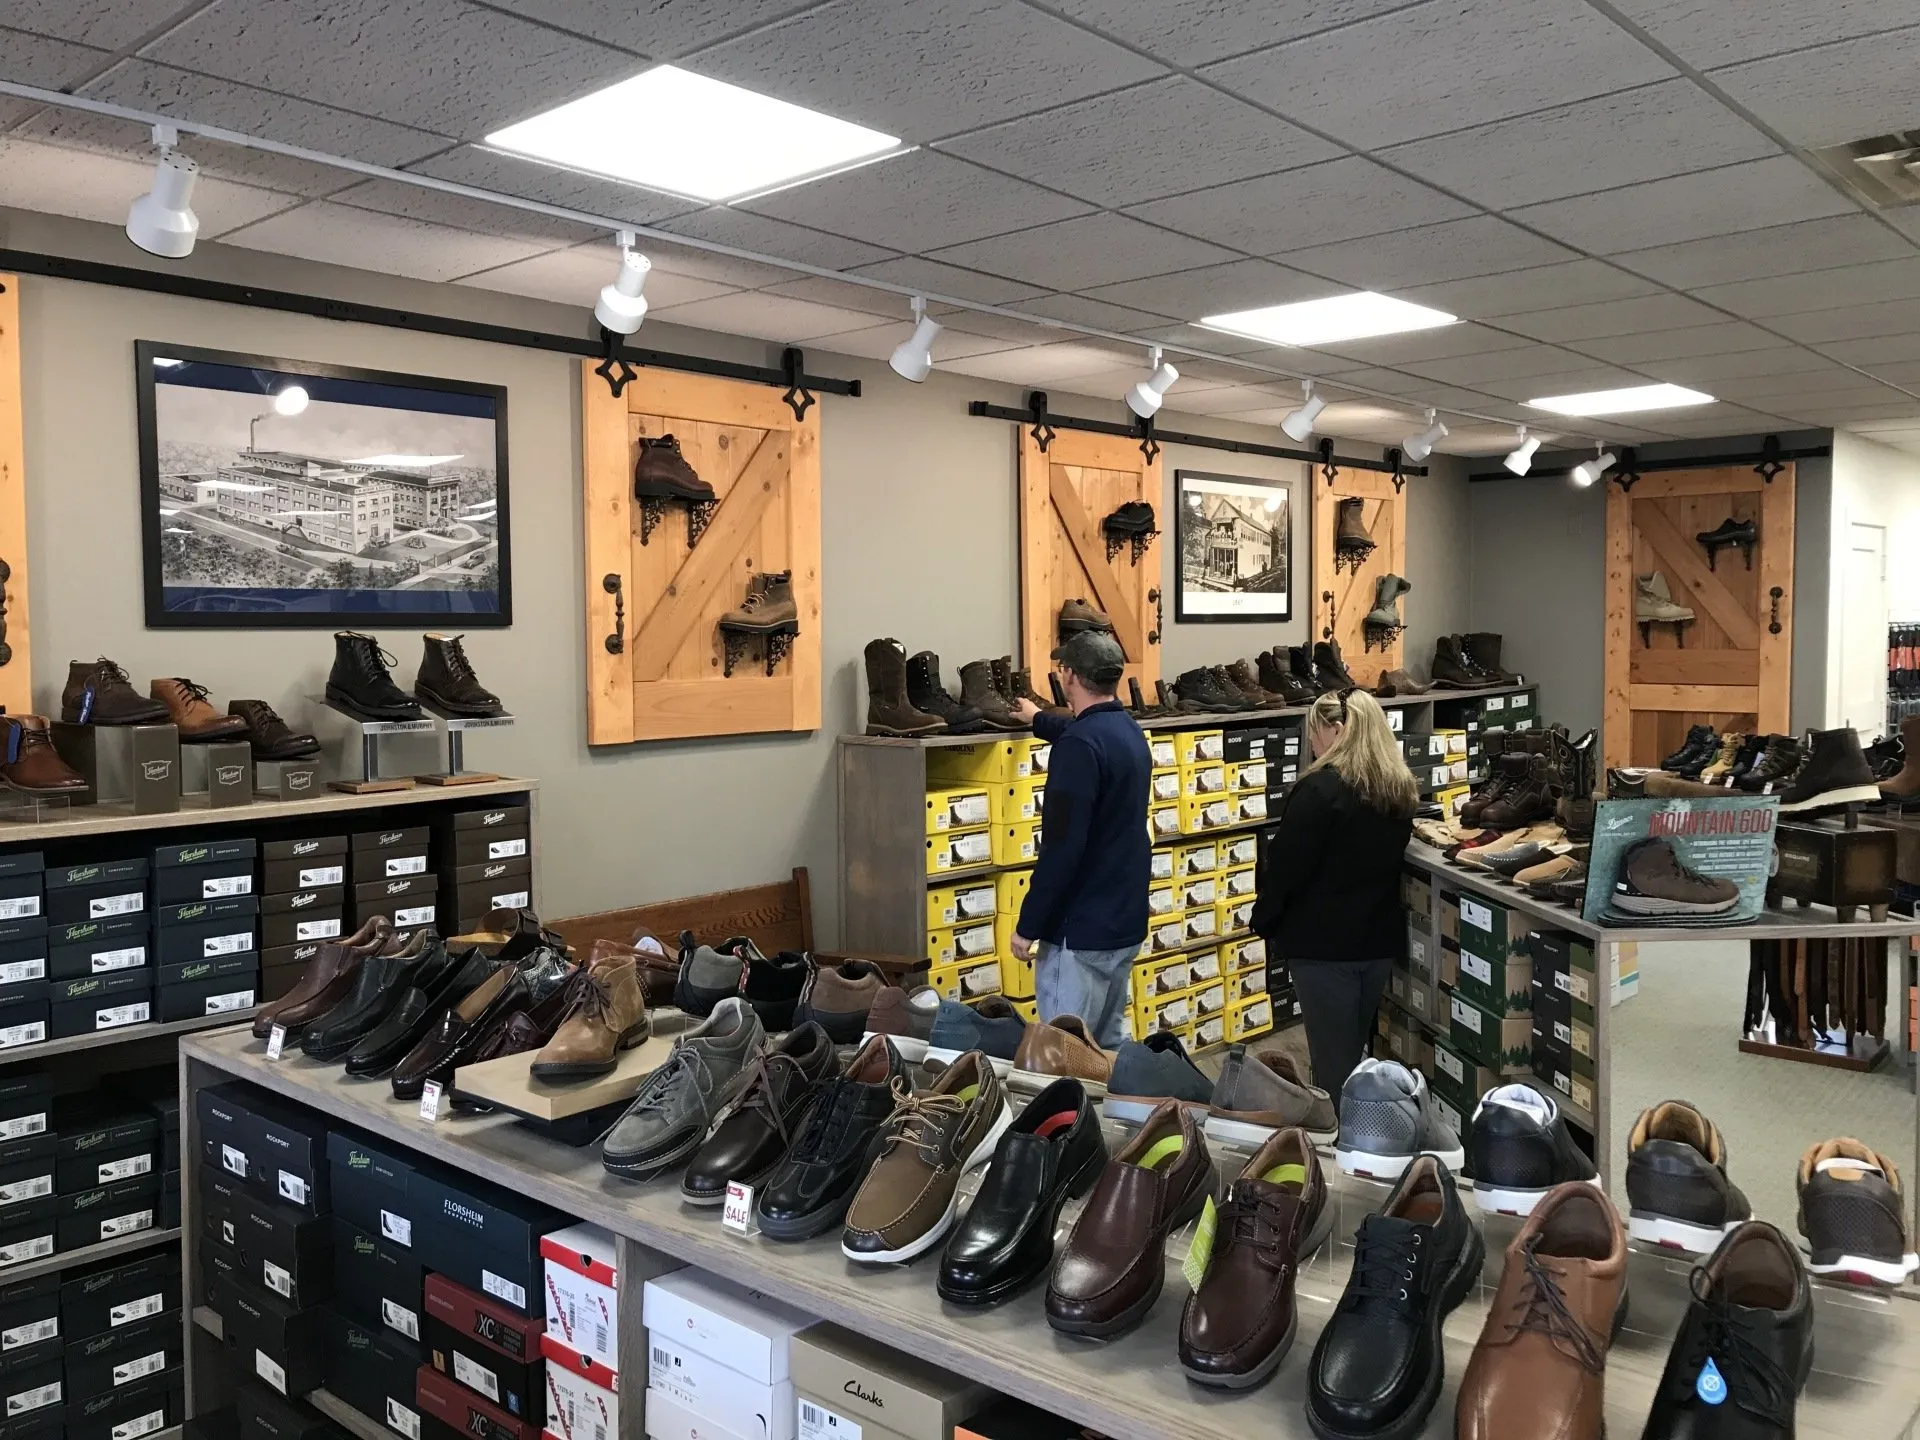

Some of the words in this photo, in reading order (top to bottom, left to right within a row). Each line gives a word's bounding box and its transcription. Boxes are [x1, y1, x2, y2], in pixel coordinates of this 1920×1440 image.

[1649, 810, 1735, 837] MOUNTAIN
[178, 847, 208, 862] Florsheim
[177, 904, 207, 920] Florsheim
[66, 923, 98, 940] Florsheim
[212, 1108, 233, 1122] ROCKPORT
[422, 1101, 436, 1116] SALE
[266, 1133, 290, 1149] ROCKPORT
[444, 1199, 484, 1224] FLORSHEIM
[725, 1205, 747, 1225] SALE
[250, 1213, 273, 1231] ROCKPORT
[843, 1380, 885, 1409] Clarks
